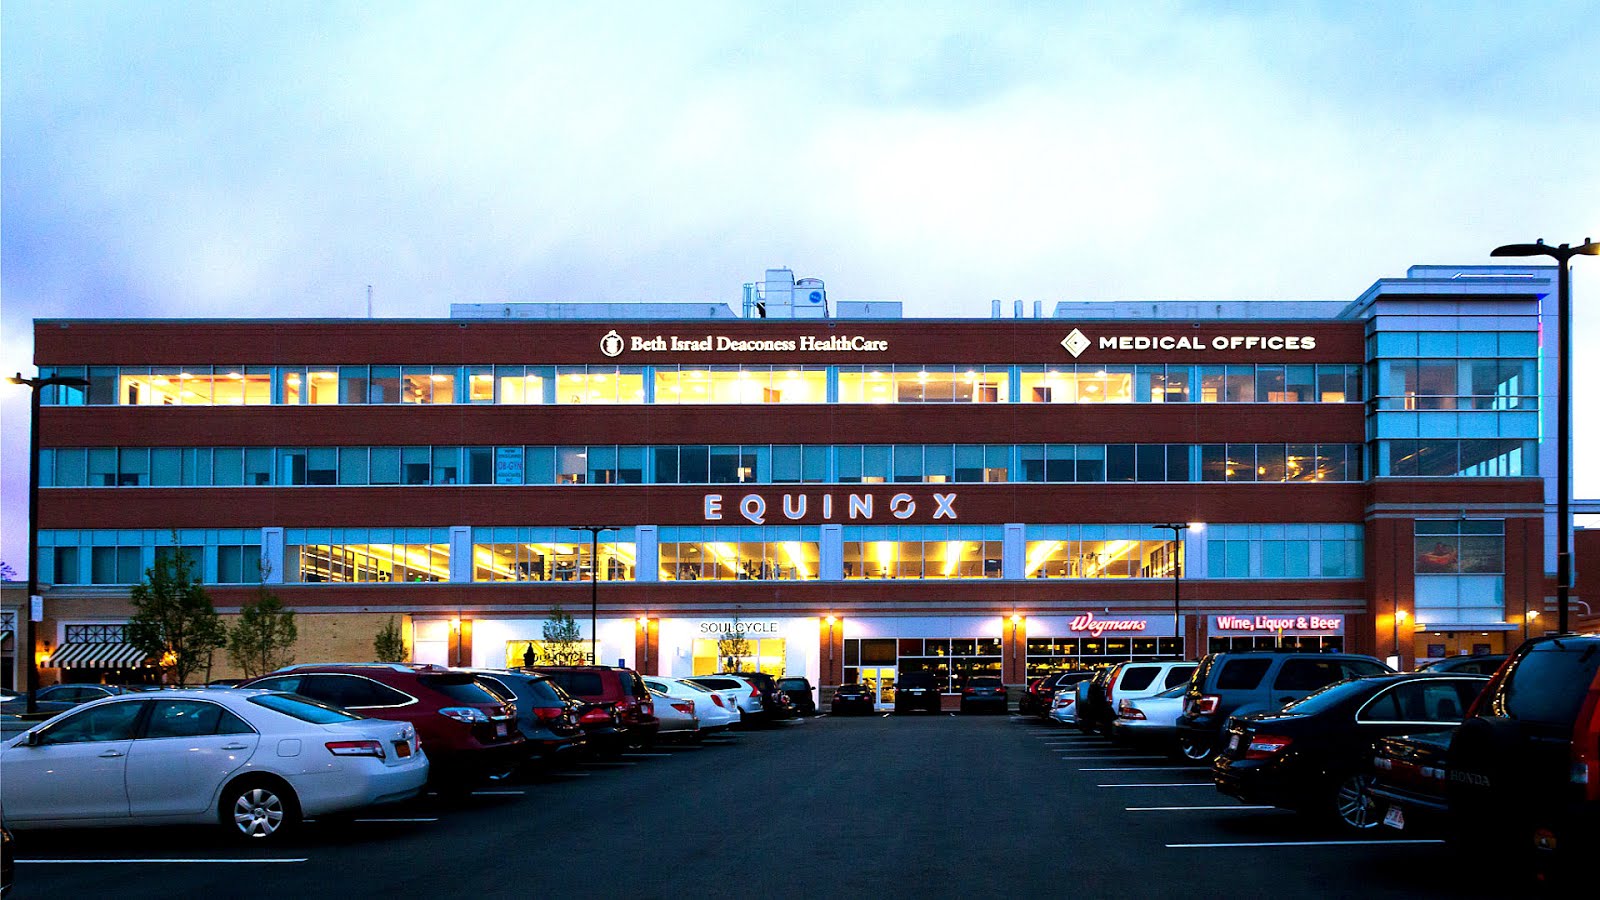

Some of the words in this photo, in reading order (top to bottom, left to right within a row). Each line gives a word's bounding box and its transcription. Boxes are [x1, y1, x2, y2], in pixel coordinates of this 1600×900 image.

[631, 336, 667, 351] Beth
[670, 336, 712, 351] Israel
[716, 336, 796, 351] Deaconess
[800, 336, 888, 351] HealthCare
[1099, 336, 1206, 350] MEDICAL
[1211, 336, 1316, 350] OFFICES
[704, 493, 957, 525] EQUINOX
[700, 622, 778, 633] SOULCYCLE
[1068, 612, 1147, 637] Wegmans
[1217, 615, 1254, 631] Wine,
[1255, 615, 1295, 632] Liquor
[1296, 616, 1308, 629] &
[1310, 616, 1341, 629] Beer
[1449, 769, 1490, 788] HONDA
